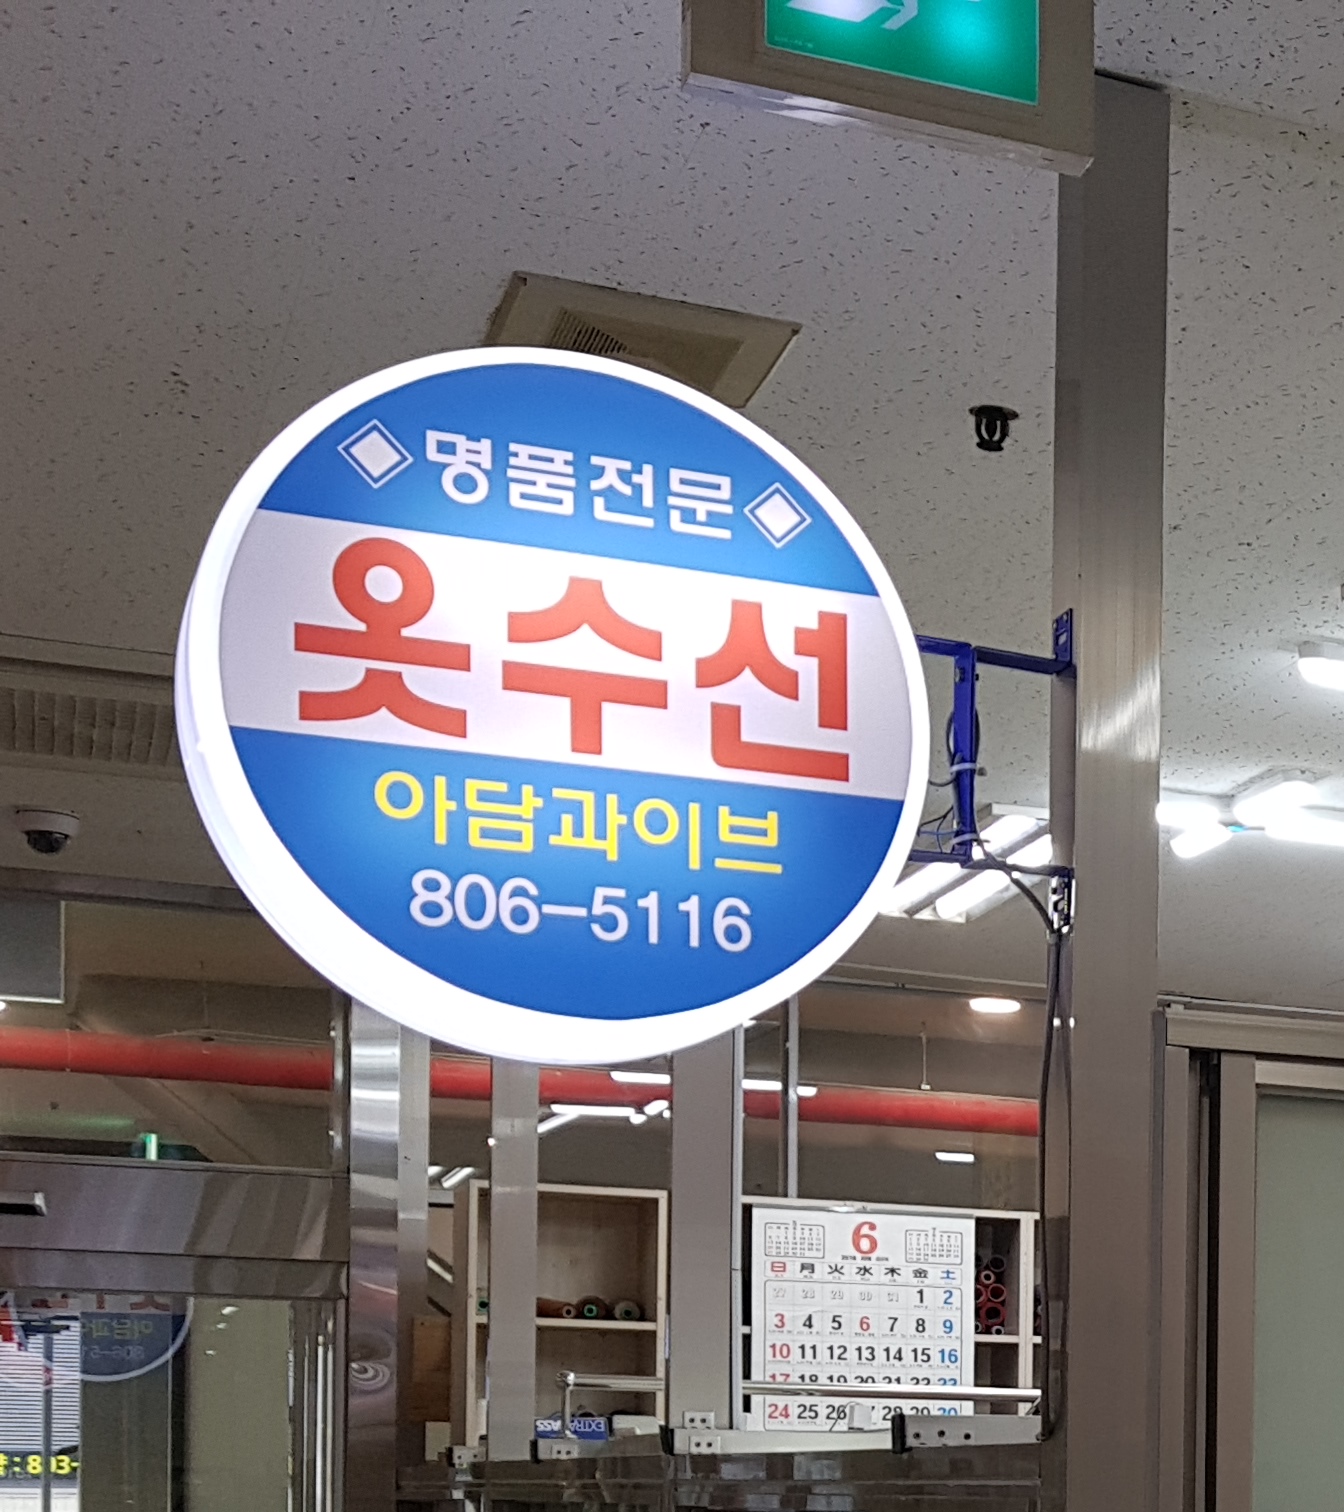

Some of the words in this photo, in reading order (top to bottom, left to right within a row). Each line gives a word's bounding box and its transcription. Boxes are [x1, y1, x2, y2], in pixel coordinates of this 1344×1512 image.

[425, 428, 735, 541] 명품전문
[294, 536, 850, 783] 옷수선
[374, 769, 783, 875] 아담과이브
[409, 868, 754, 952] 806-5116
[852, 1221, 878, 1255] 6
[771, 1261, 786, 1273] 日
[799, 1263, 815, 1274] 月
[827, 1264, 845, 1276] 火
[855, 1265, 874, 1277] 水
[884, 1267, 901, 1278] 木
[912, 1268, 928, 1279] 金
[940, 1269, 957, 1280] 土
[916, 1289, 924, 1303] 1
[943, 1290, 954, 1305] 2
[774, 1313, 786, 1329] 3
[802, 1314, 813, 1329] 4
[831, 1315, 842, 1330] 5
[859, 1316, 871, 1331] 6
[888, 1317, 898, 1332] 7
[915, 1318, 926, 1333] 8
[942, 1319, 953, 1334] 9
[769, 1343, 791, 1359] 10
[798, 1344, 817, 1359] 11
[827, 1345, 848, 1361] 12
[855, 1346, 876, 1361] 13
[883, 1347, 903, 1362] 14
[911, 1348, 931, 1363] 15
[938, 1348, 958, 1364] 16
[768, 1403, 790, 1419] 24
[797, 1404, 818, 1420] 25
[826, 1404, 847, 1420] 26
